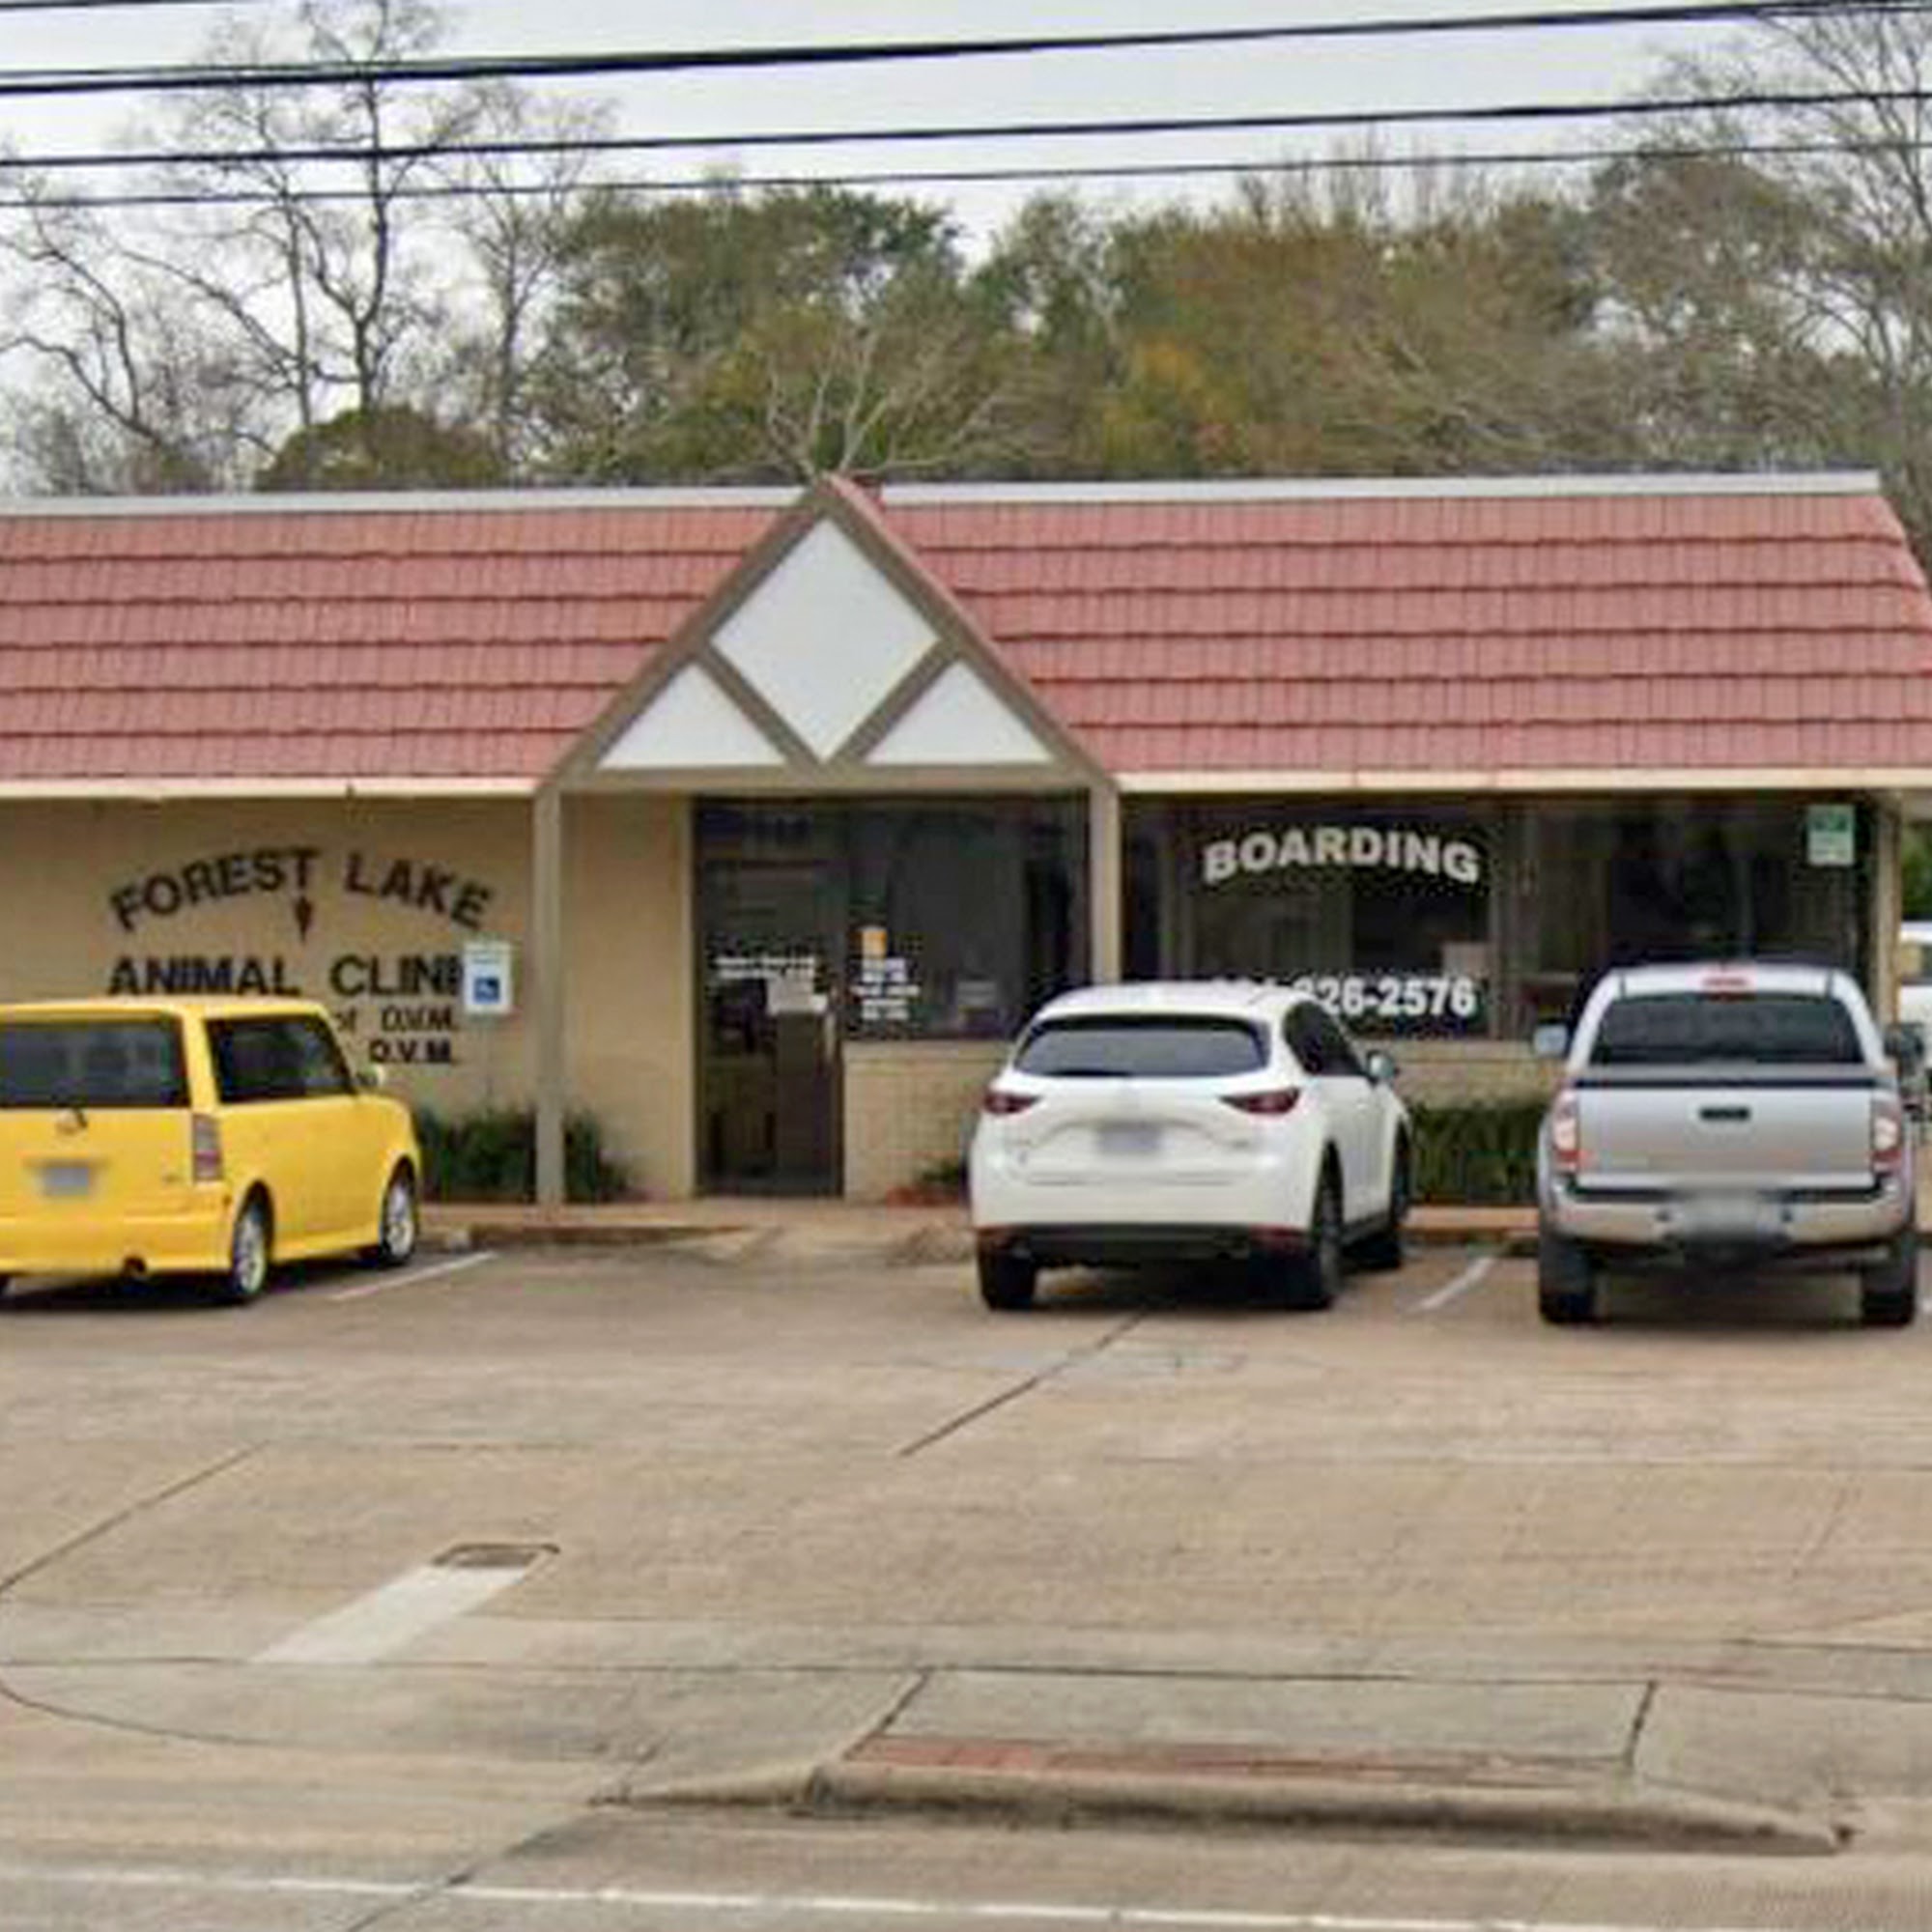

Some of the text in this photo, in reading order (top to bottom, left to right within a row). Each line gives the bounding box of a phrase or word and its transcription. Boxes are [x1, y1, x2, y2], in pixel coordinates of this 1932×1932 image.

[1205, 827, 1481, 884] BOARDING
[109, 847, 494, 931] FOREST LAKE
[108, 953, 465, 997] ANIMAL CLINI
